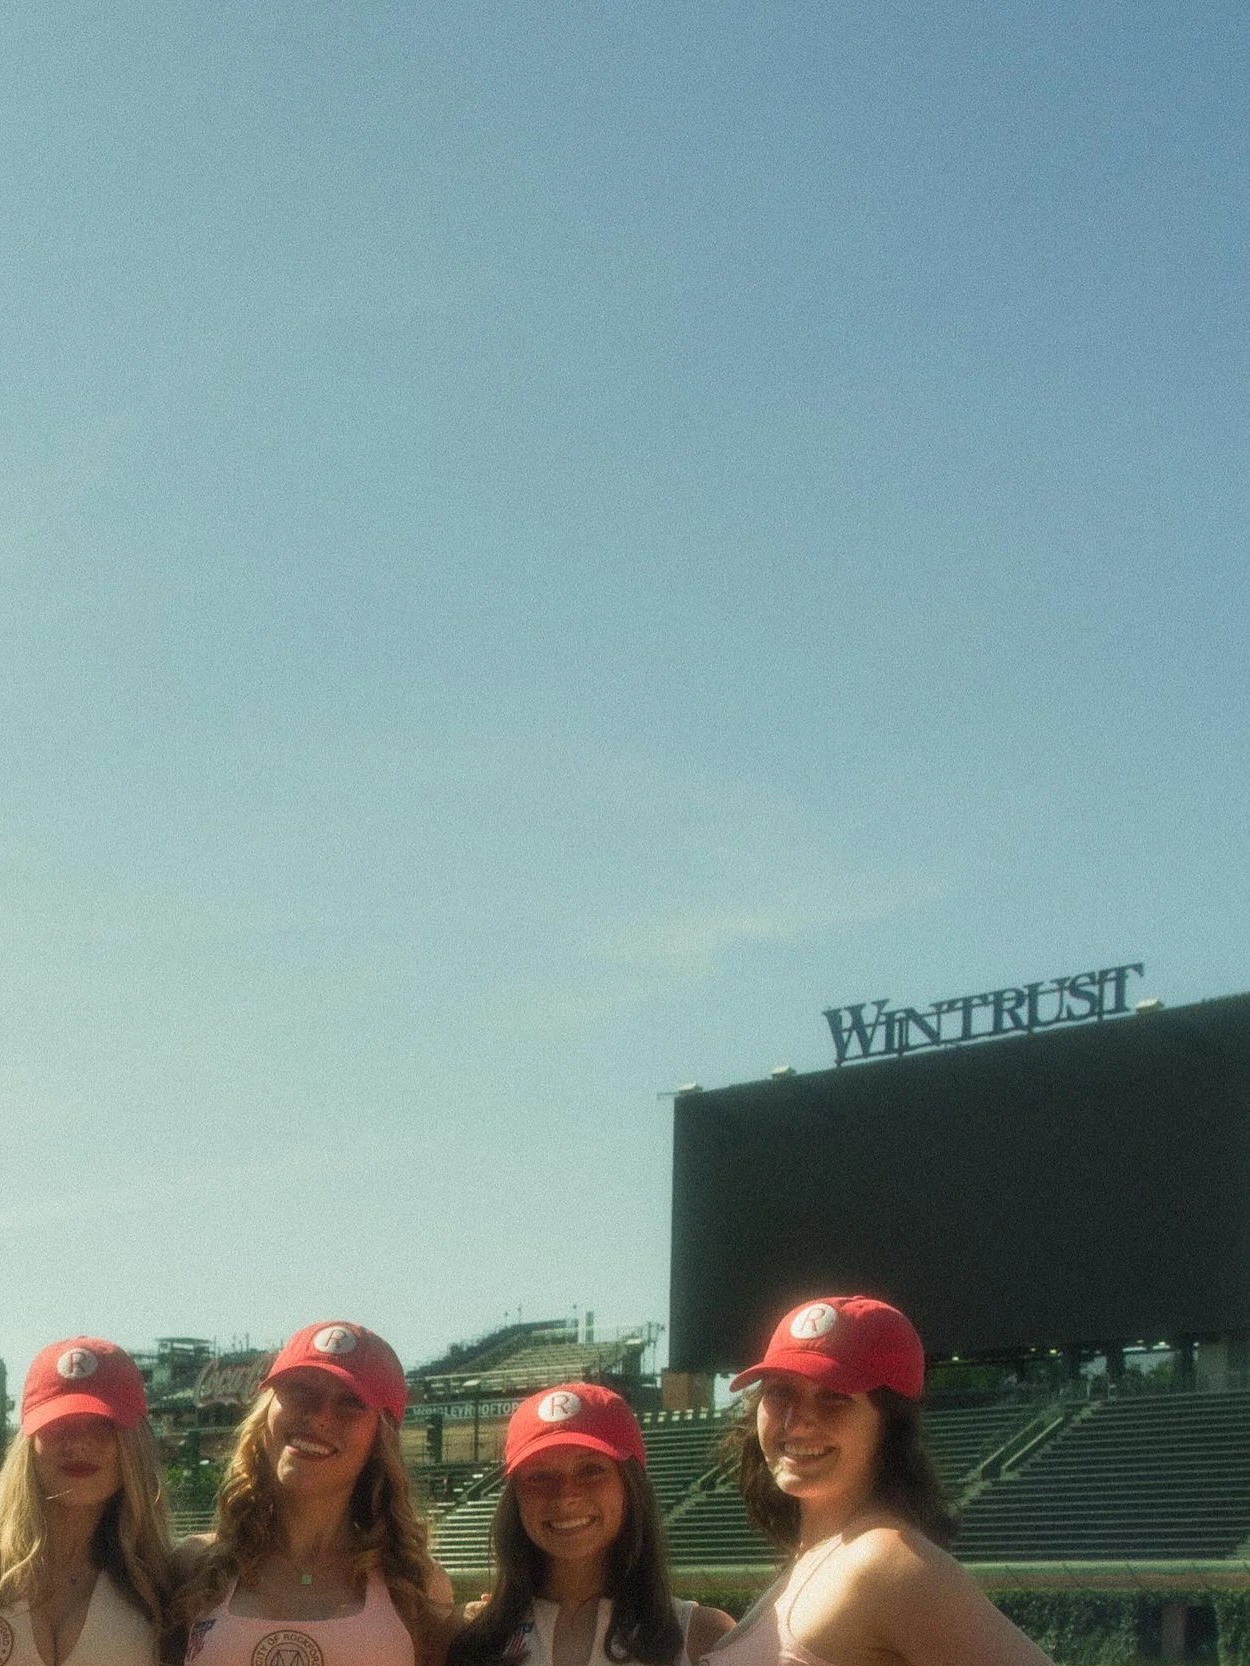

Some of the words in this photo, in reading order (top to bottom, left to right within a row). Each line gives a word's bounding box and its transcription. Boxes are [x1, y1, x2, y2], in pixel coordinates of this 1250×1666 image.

[822, 962, 1144, 1061] WINTRUST
[800, 1308, 826, 1332] R
[325, 1329, 347, 1349] R
[70, 1352, 88, 1374] R
[551, 1395, 569, 1417] R
[255, 1645, 267, 1666] CITY
[268, 1634, 279, 1646] OF
